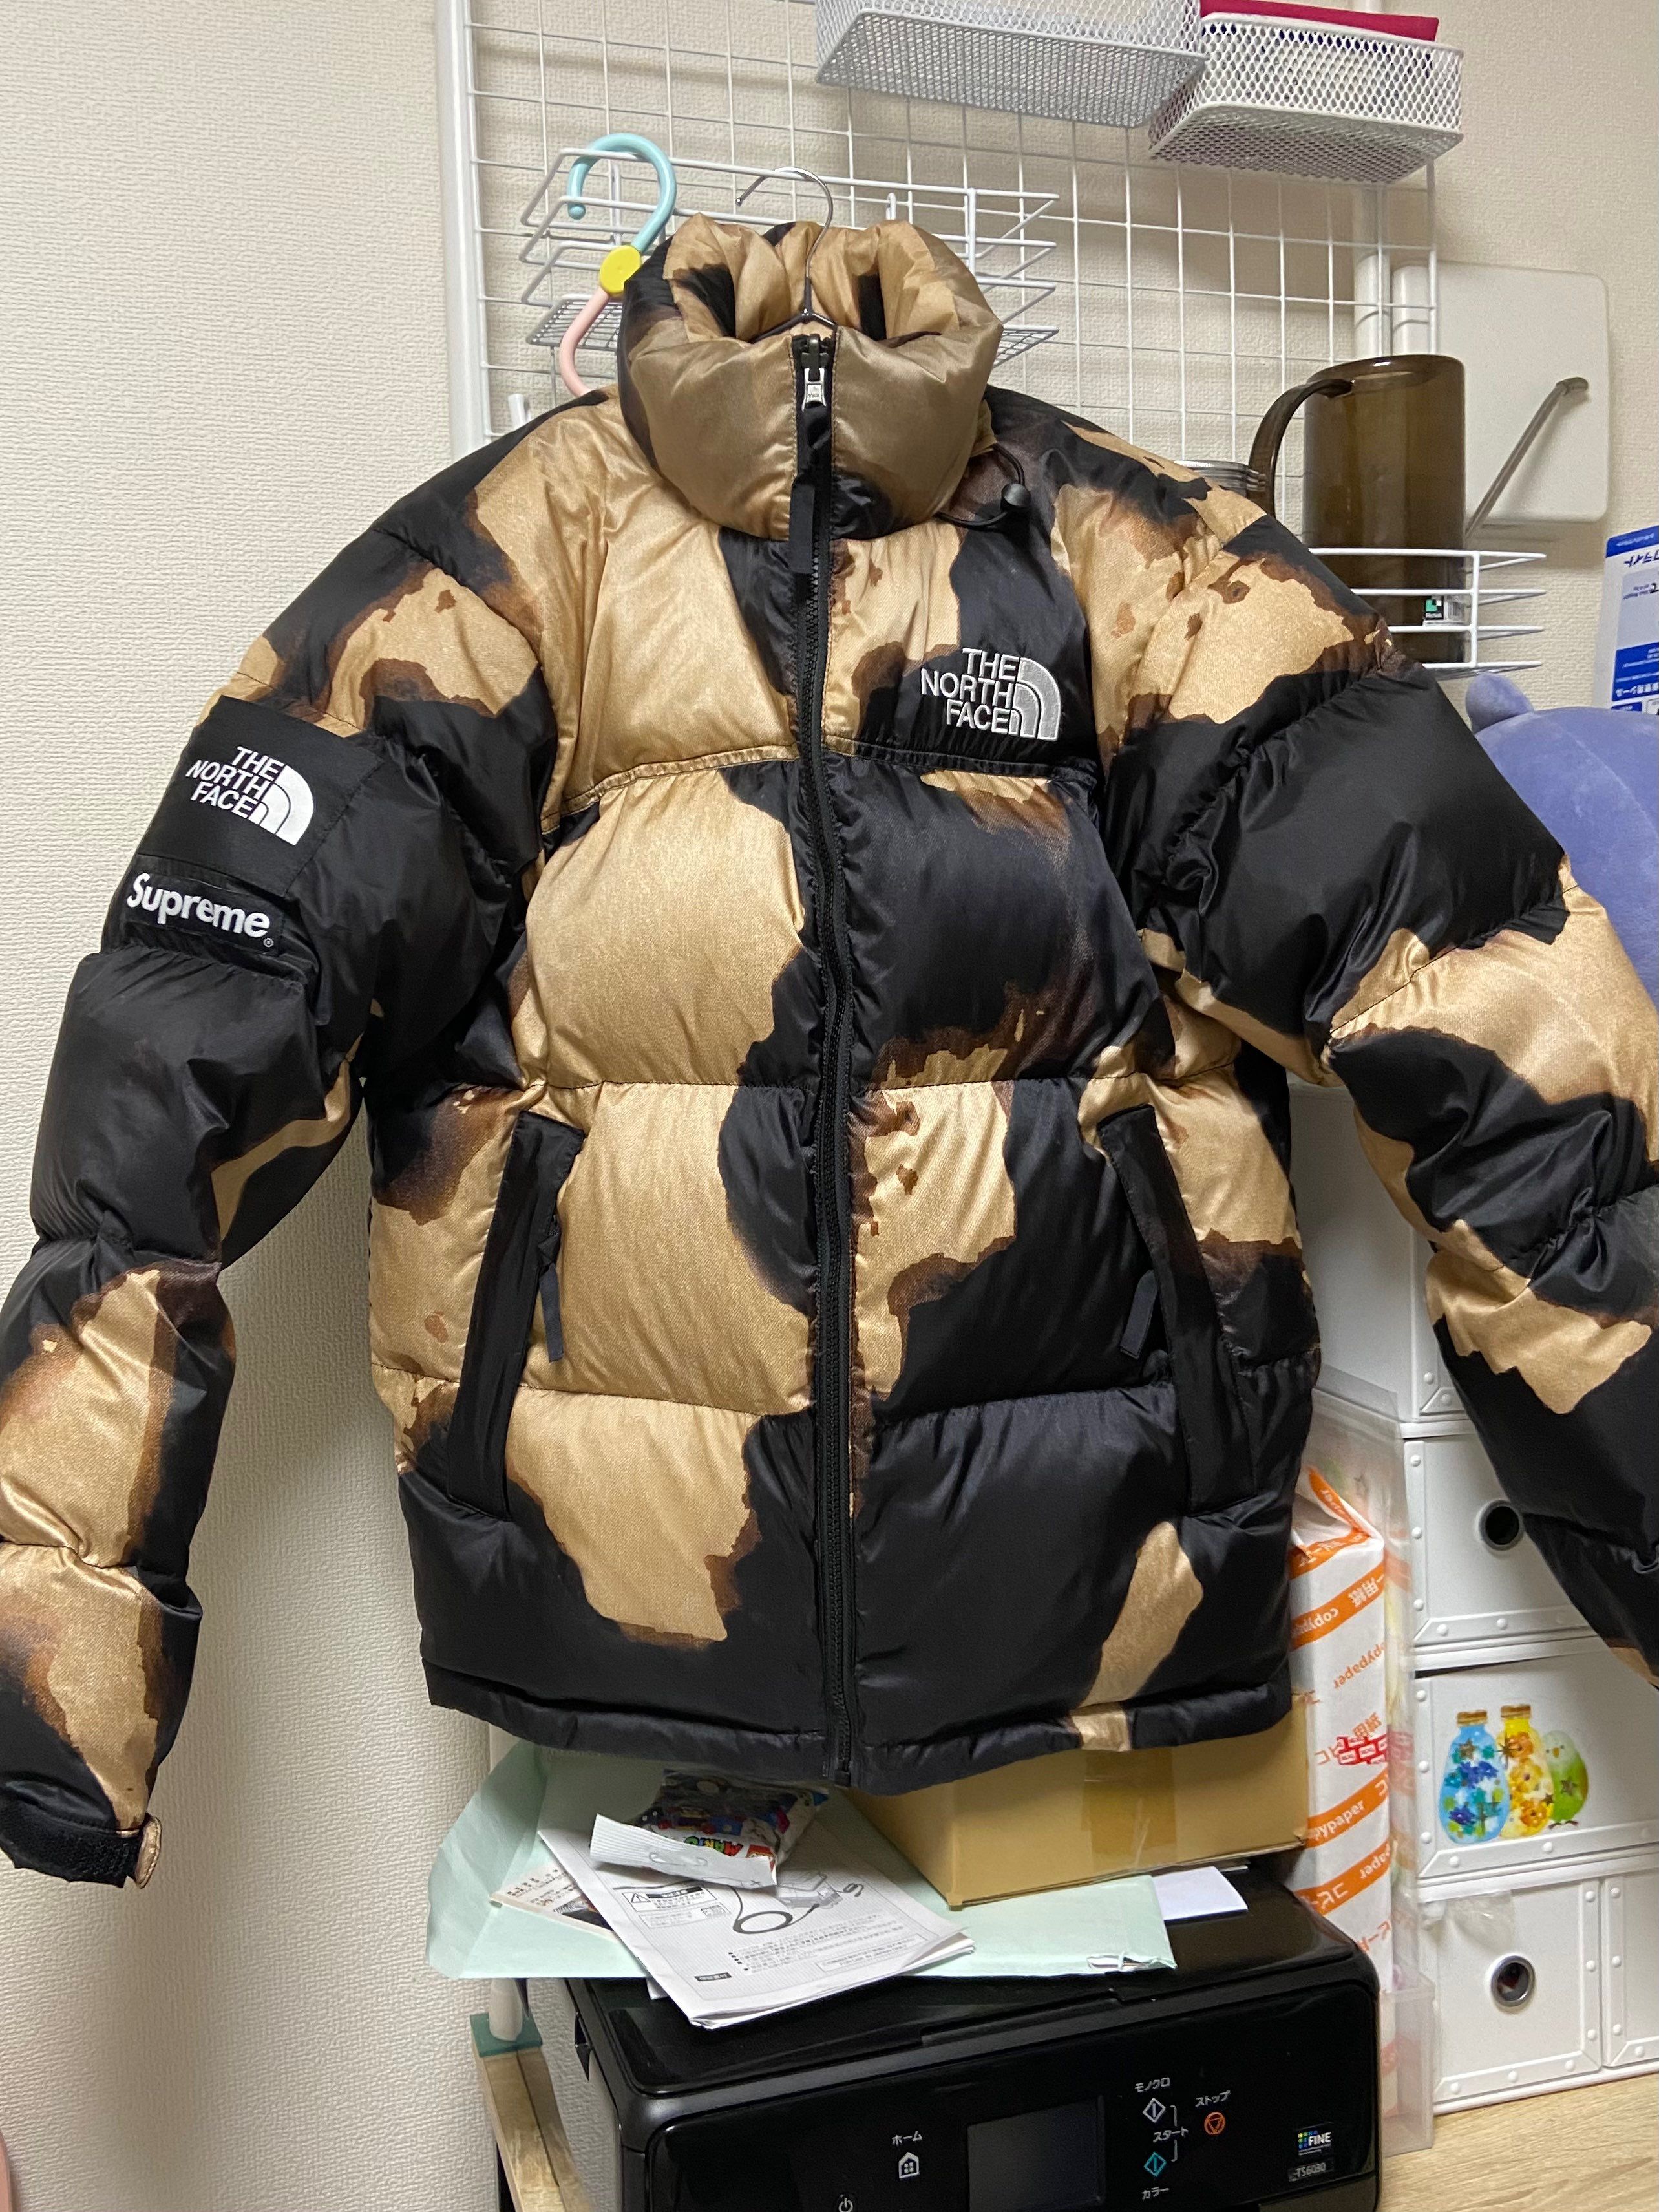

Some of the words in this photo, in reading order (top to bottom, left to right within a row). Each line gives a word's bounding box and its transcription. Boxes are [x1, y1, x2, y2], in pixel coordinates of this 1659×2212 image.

[962, 648, 1020, 682] THE
[921, 668, 1015, 708] NORTH
[946, 699, 1010, 735] FACE
[185, 760, 270, 800] NORTH
[231, 746, 284, 781] THE
[191, 782, 259, 818] FACE
[127, 872, 271, 938] Supreme
[1135, 2077, 1170, 2093] モノクロ
[1195, 2090, 1231, 2108] ストップ
[892, 2131, 922, 2146] ホーム
[1153, 2127, 1189, 2143] スタート
[1308, 2132, 1331, 2147] FINE
[1141, 2187, 1170, 2200] カラー
